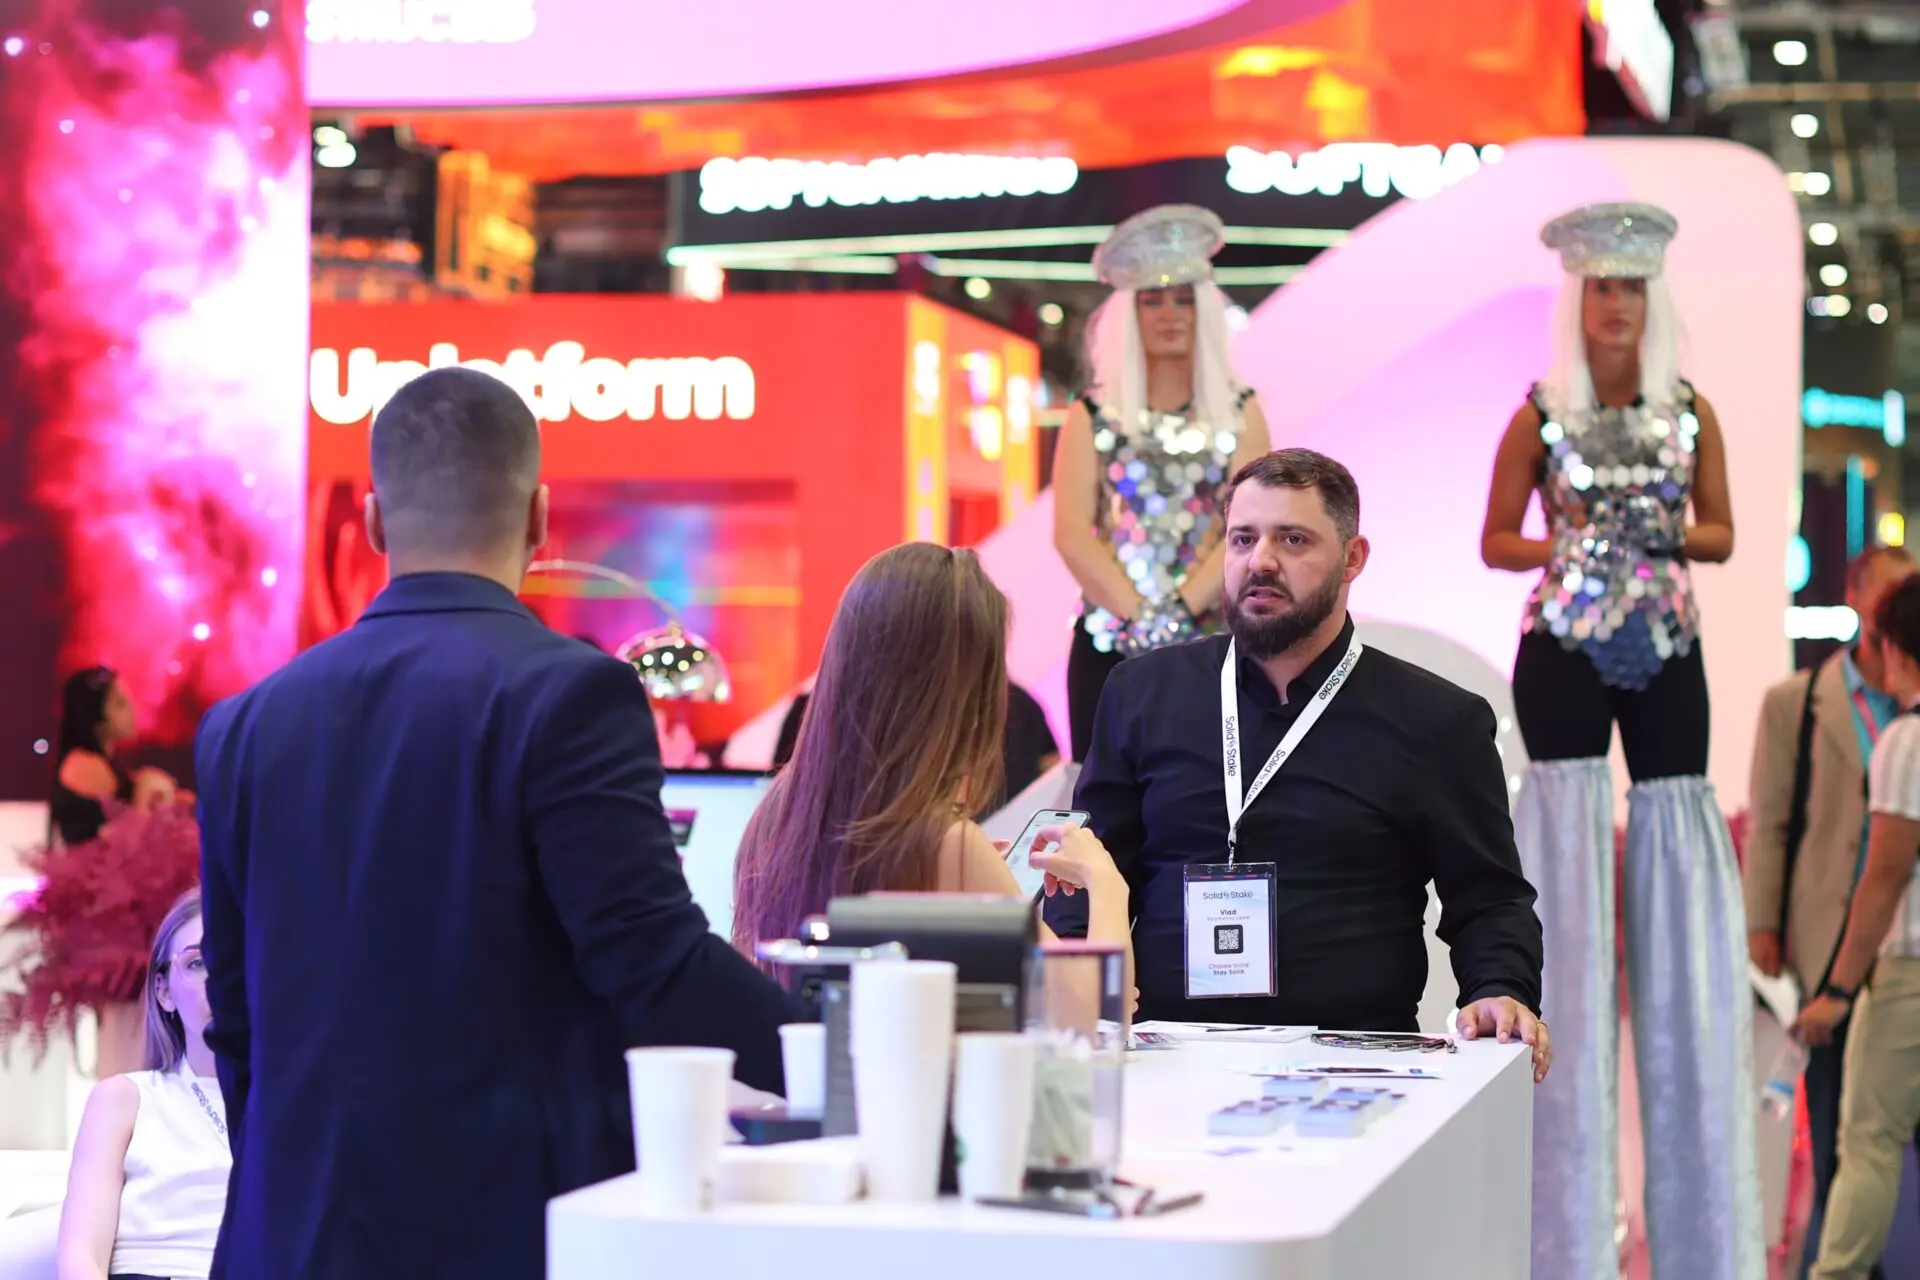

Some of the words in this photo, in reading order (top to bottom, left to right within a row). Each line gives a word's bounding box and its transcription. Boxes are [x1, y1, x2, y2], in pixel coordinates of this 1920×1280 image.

[310, 340, 755, 424] Utform
[1341, 649, 1357, 672] Solid
[1318, 674, 1340, 700] Stake
[1225, 715, 1236, 740] Solid
[1227, 748, 1238, 777] Stake
[1264, 749, 1286, 773] Solid
[1202, 891, 1223, 900] Solid
[1230, 889, 1253, 899] Stake
